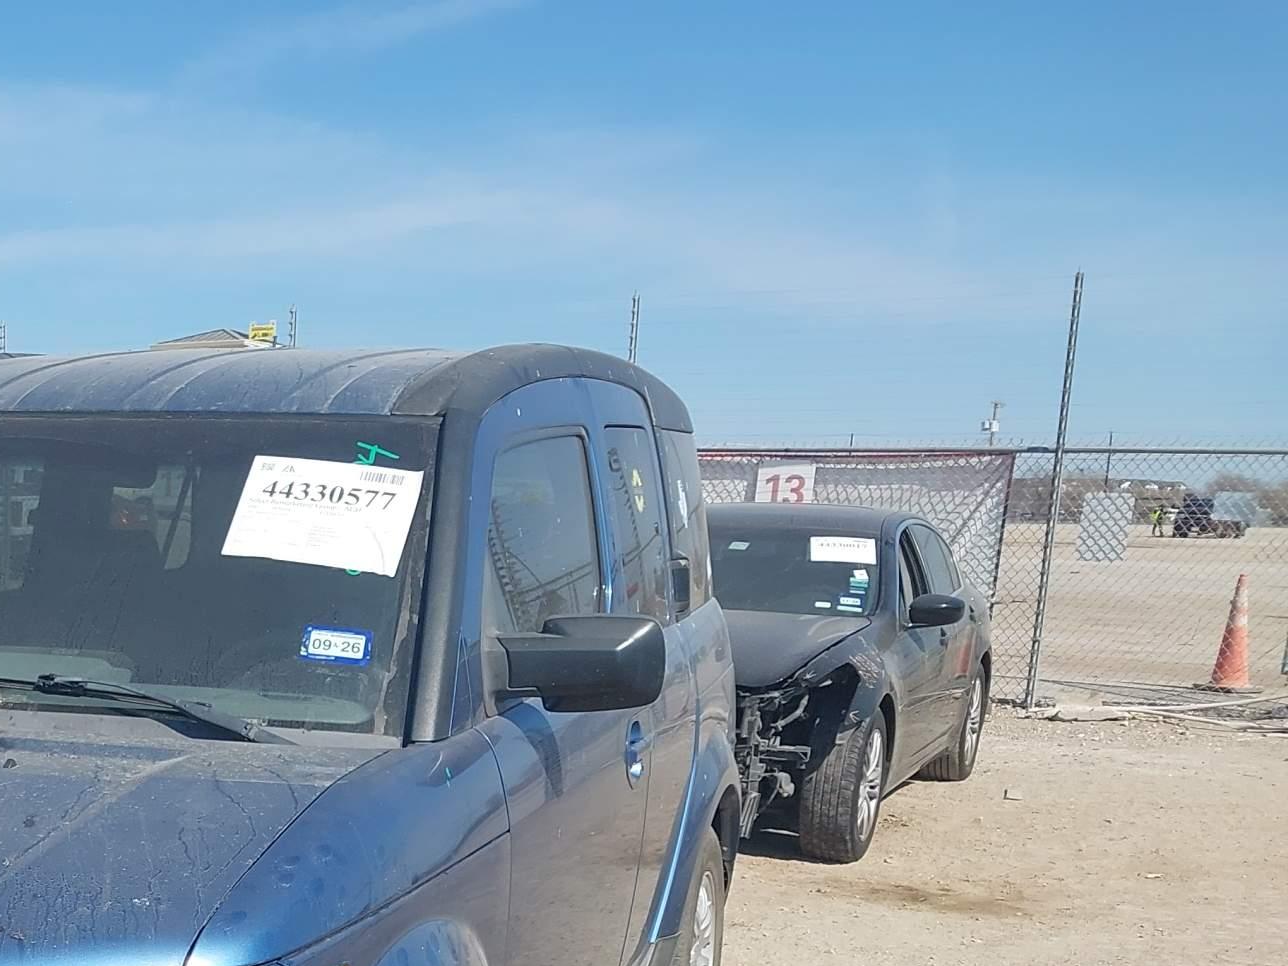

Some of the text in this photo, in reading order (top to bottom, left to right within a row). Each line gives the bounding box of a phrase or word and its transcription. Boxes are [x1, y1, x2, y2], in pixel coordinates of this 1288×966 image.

[262, 480, 397, 510] 44330577
[765, 474, 806, 502] 13
[312, 638, 361, 653] 09 26
